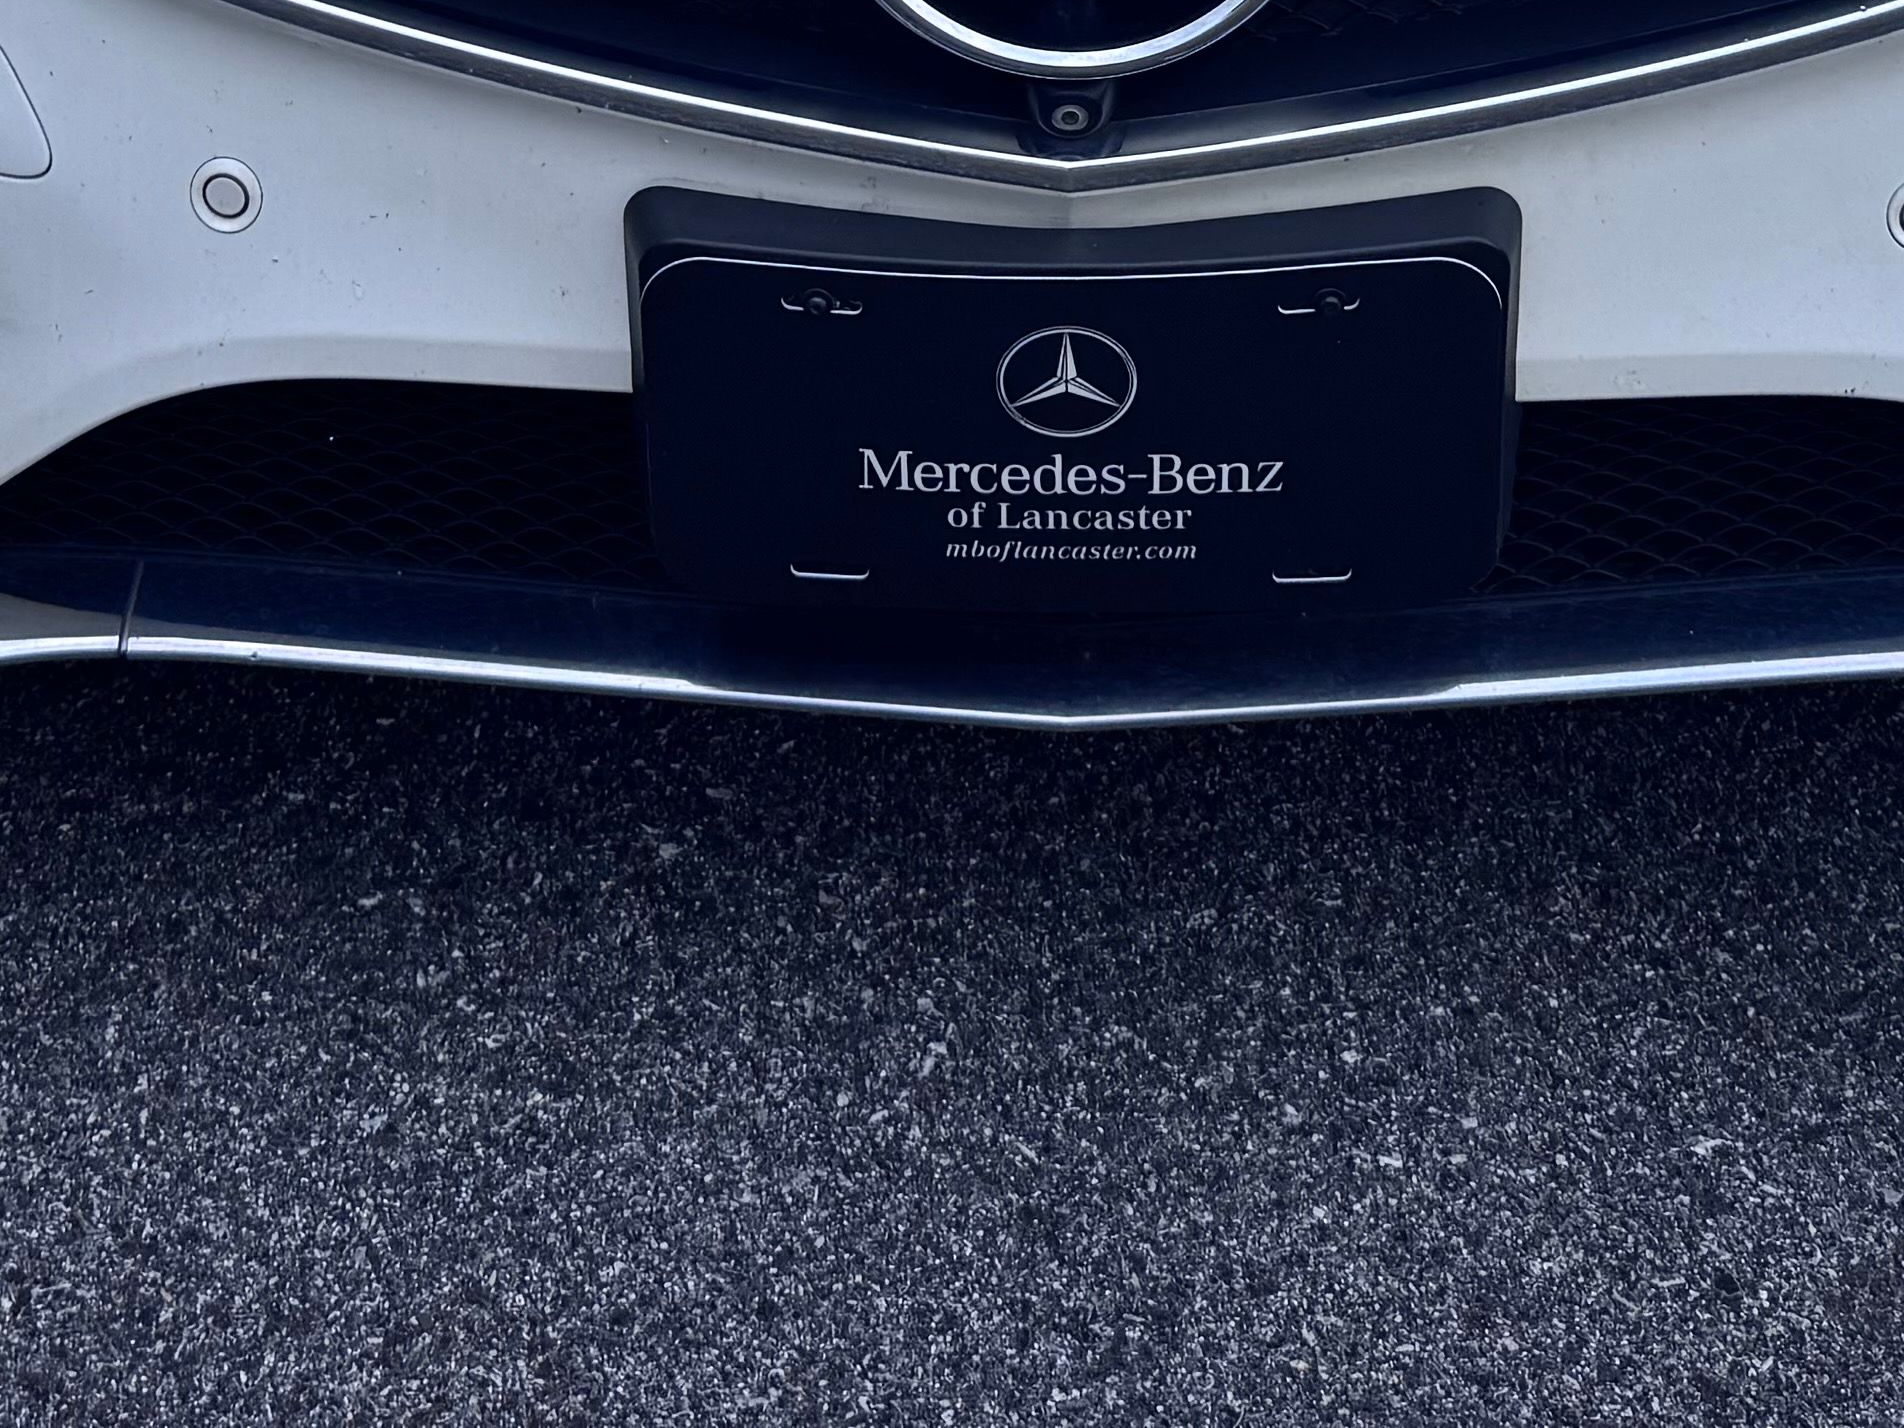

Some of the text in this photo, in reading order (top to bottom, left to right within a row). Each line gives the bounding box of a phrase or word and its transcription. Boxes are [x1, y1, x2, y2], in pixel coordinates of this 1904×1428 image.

[858, 447, 1284, 495] Mercedes-Benz
[947, 501, 1192, 530] of Lancaster
[946, 540, 1197, 562] mboflancaster.com
